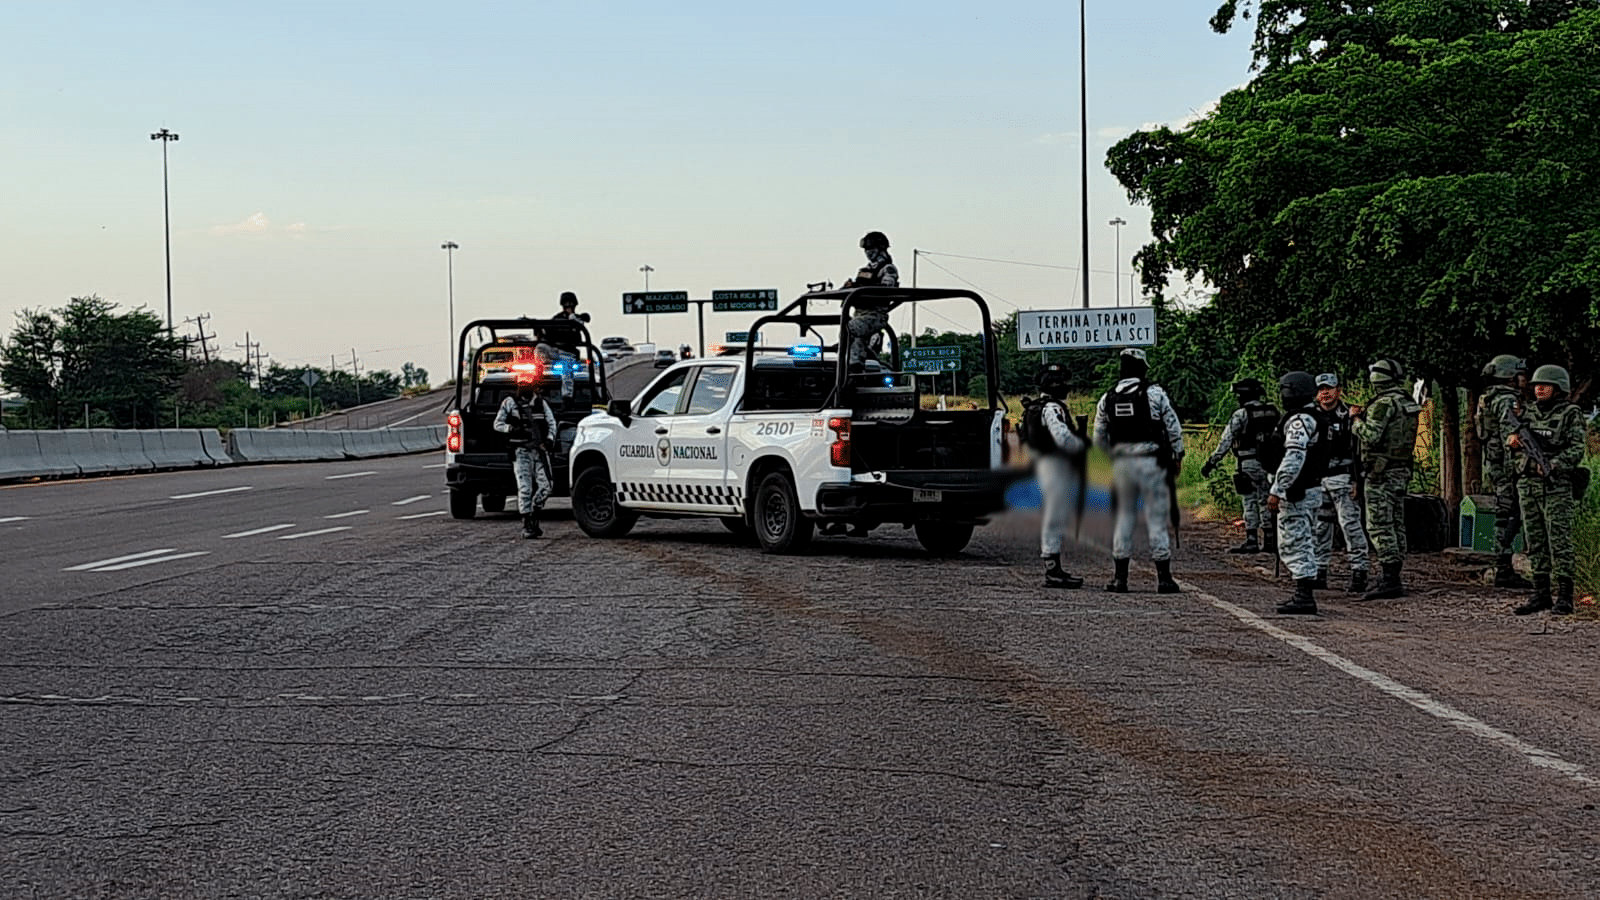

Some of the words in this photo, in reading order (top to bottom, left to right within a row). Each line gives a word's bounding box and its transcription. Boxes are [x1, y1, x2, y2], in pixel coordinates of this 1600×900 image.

[1038, 314, 1089, 328] TERMINA
[1097, 312, 1136, 326] TRAMO
[1025, 332, 1031, 345] A
[1039, 330, 1078, 344] CARGO
[1086, 329, 1099, 342] DE
[1107, 328, 1121, 341] LA
[1129, 327, 1150, 340] SCT
[756, 422, 794, 435] 26101
[620, 445, 655, 458] GUARDIA
[673, 445, 717, 459] NACIONAL
